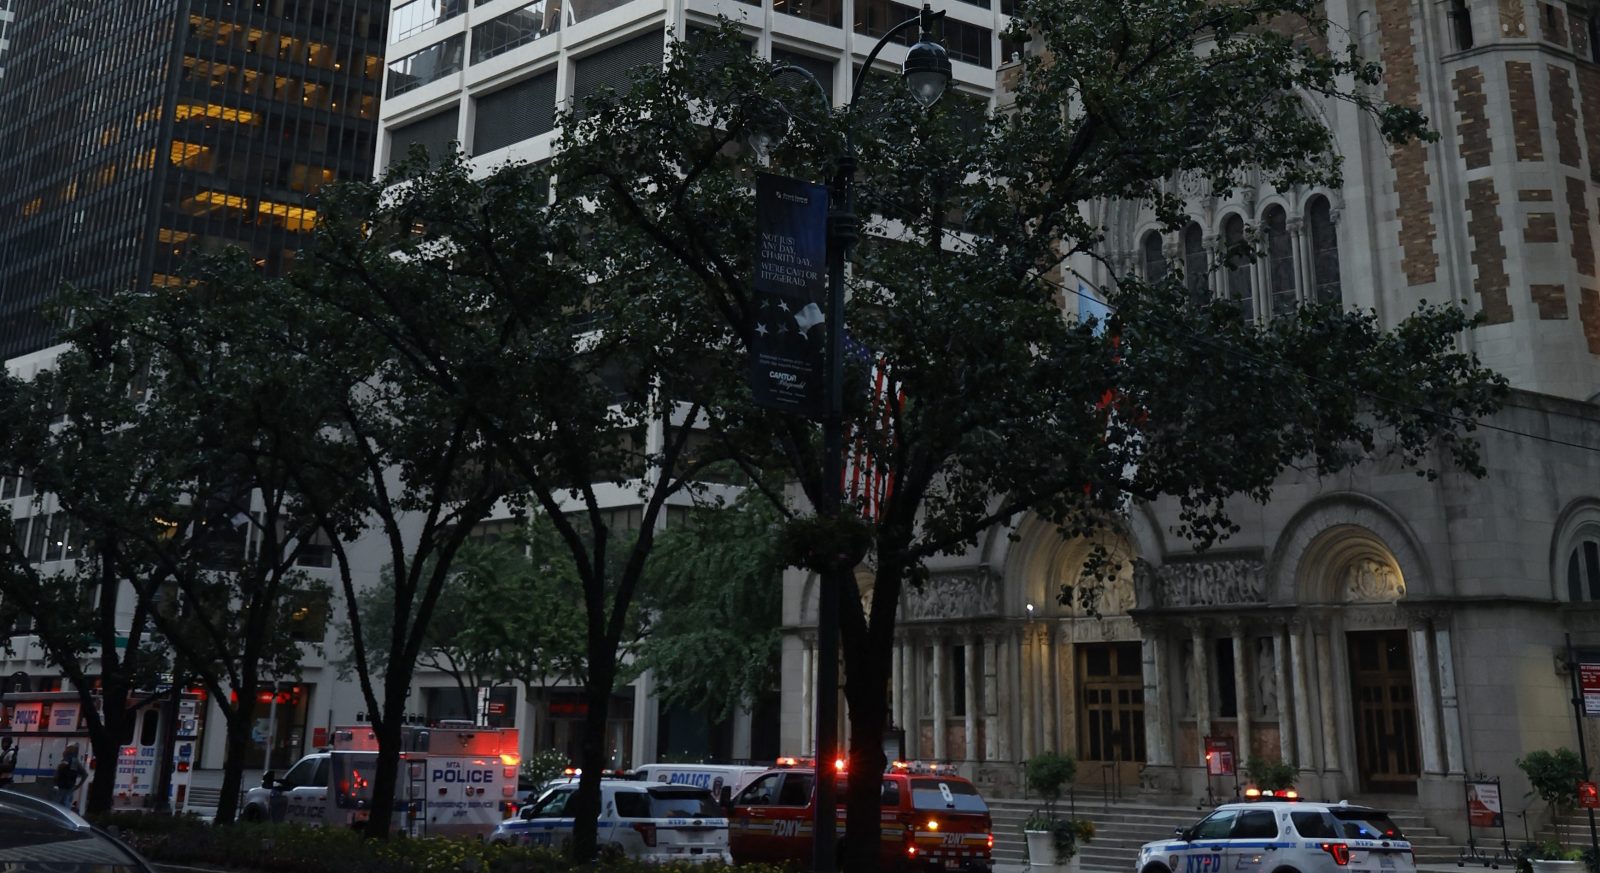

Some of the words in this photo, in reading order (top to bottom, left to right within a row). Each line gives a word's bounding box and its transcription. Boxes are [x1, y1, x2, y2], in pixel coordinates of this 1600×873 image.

[761, 232, 777, 242] NOT
[761, 241, 777, 251] ANY
[761, 250, 796, 264] CHARITY
[769, 370, 797, 382] CANTOR
[15, 710, 39, 724] POLICE
[432, 769, 493, 783] POLICE
[671, 773, 711, 789] POLICE
[938, 782, 954, 802] 8
[288, 805, 326, 818] POLICE
[771, 819, 802, 837] FDNY
[942, 831, 967, 845] FDNY
[1186, 853, 1221, 873] NYPD
